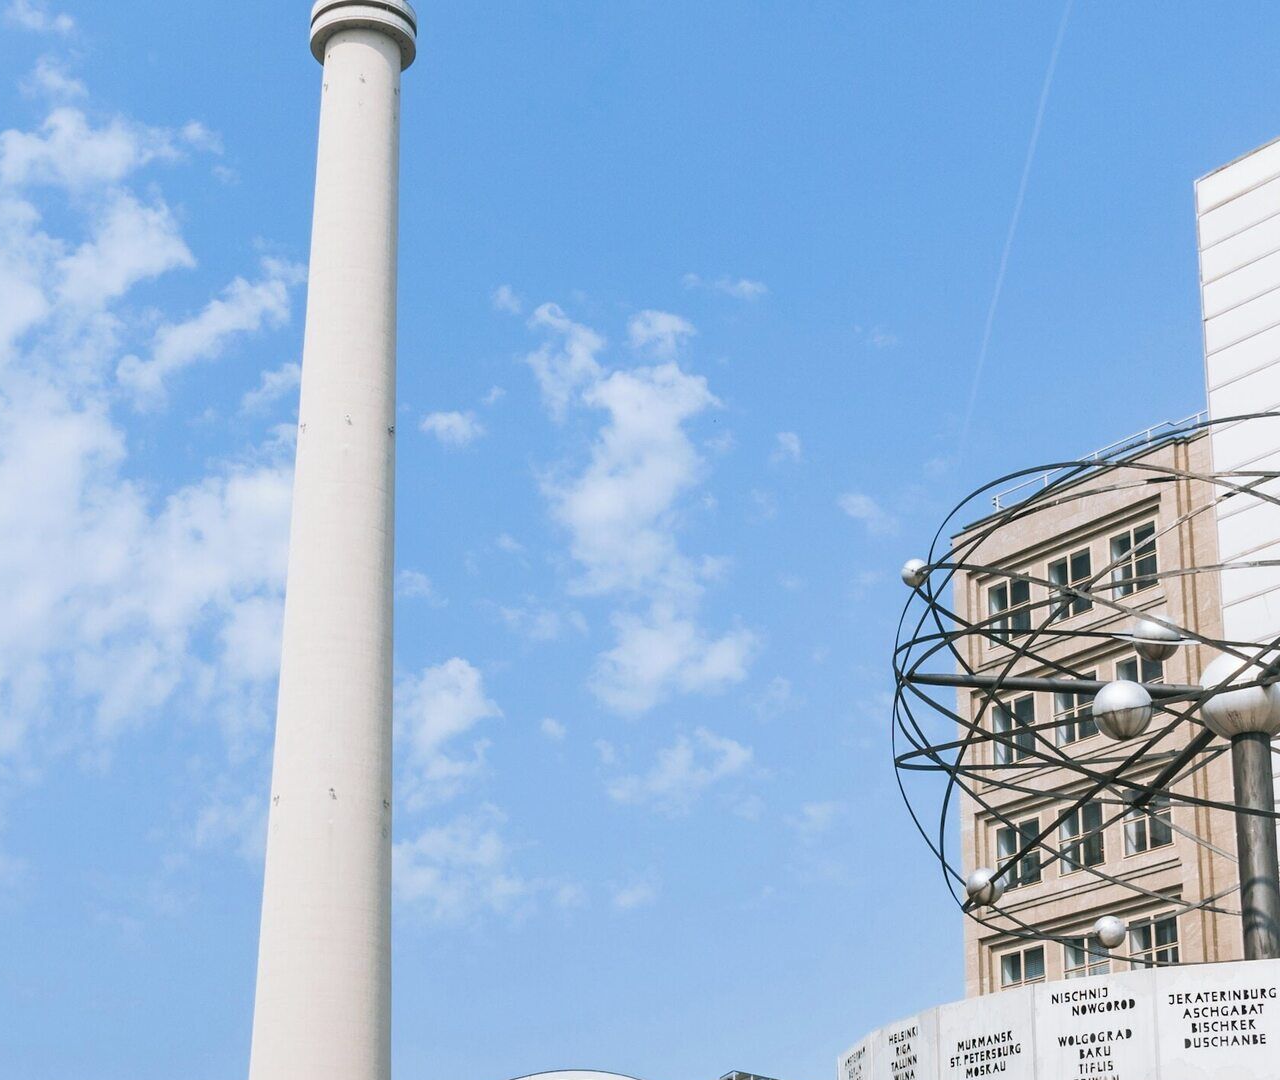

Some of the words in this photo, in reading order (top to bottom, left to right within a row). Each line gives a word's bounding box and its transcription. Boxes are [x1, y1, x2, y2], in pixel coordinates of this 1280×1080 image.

[1051, 987, 1108, 1005] NISCHNIJ
[1168, 988, 1277, 1004] JEKATERINBURG
[1072, 998, 1136, 1016] NOWGOROD
[1182, 1004, 1264, 1020] ASCHGABAT
[888, 1026, 919, 1046] HELSINKI
[1191, 1020, 1256, 1034] BISCHKEK
[958, 1030, 1013, 1052] MURMANSK
[1058, 1028, 1132, 1048] WOLGOGRAD
[1184, 1034, 1266, 1049] DUSCHANBE
[896, 1045, 912, 1056] RIGA
[950, 1054, 965, 1068] ST.
[964, 1043, 1022, 1065] PETERSBURG
[1080, 1046, 1112, 1060] BAKU
[891, 1054, 918, 1072] TALLINN
[966, 1061, 1006, 1079] MOSKAU
[1078, 1060, 1114, 1075] TIFLIS
